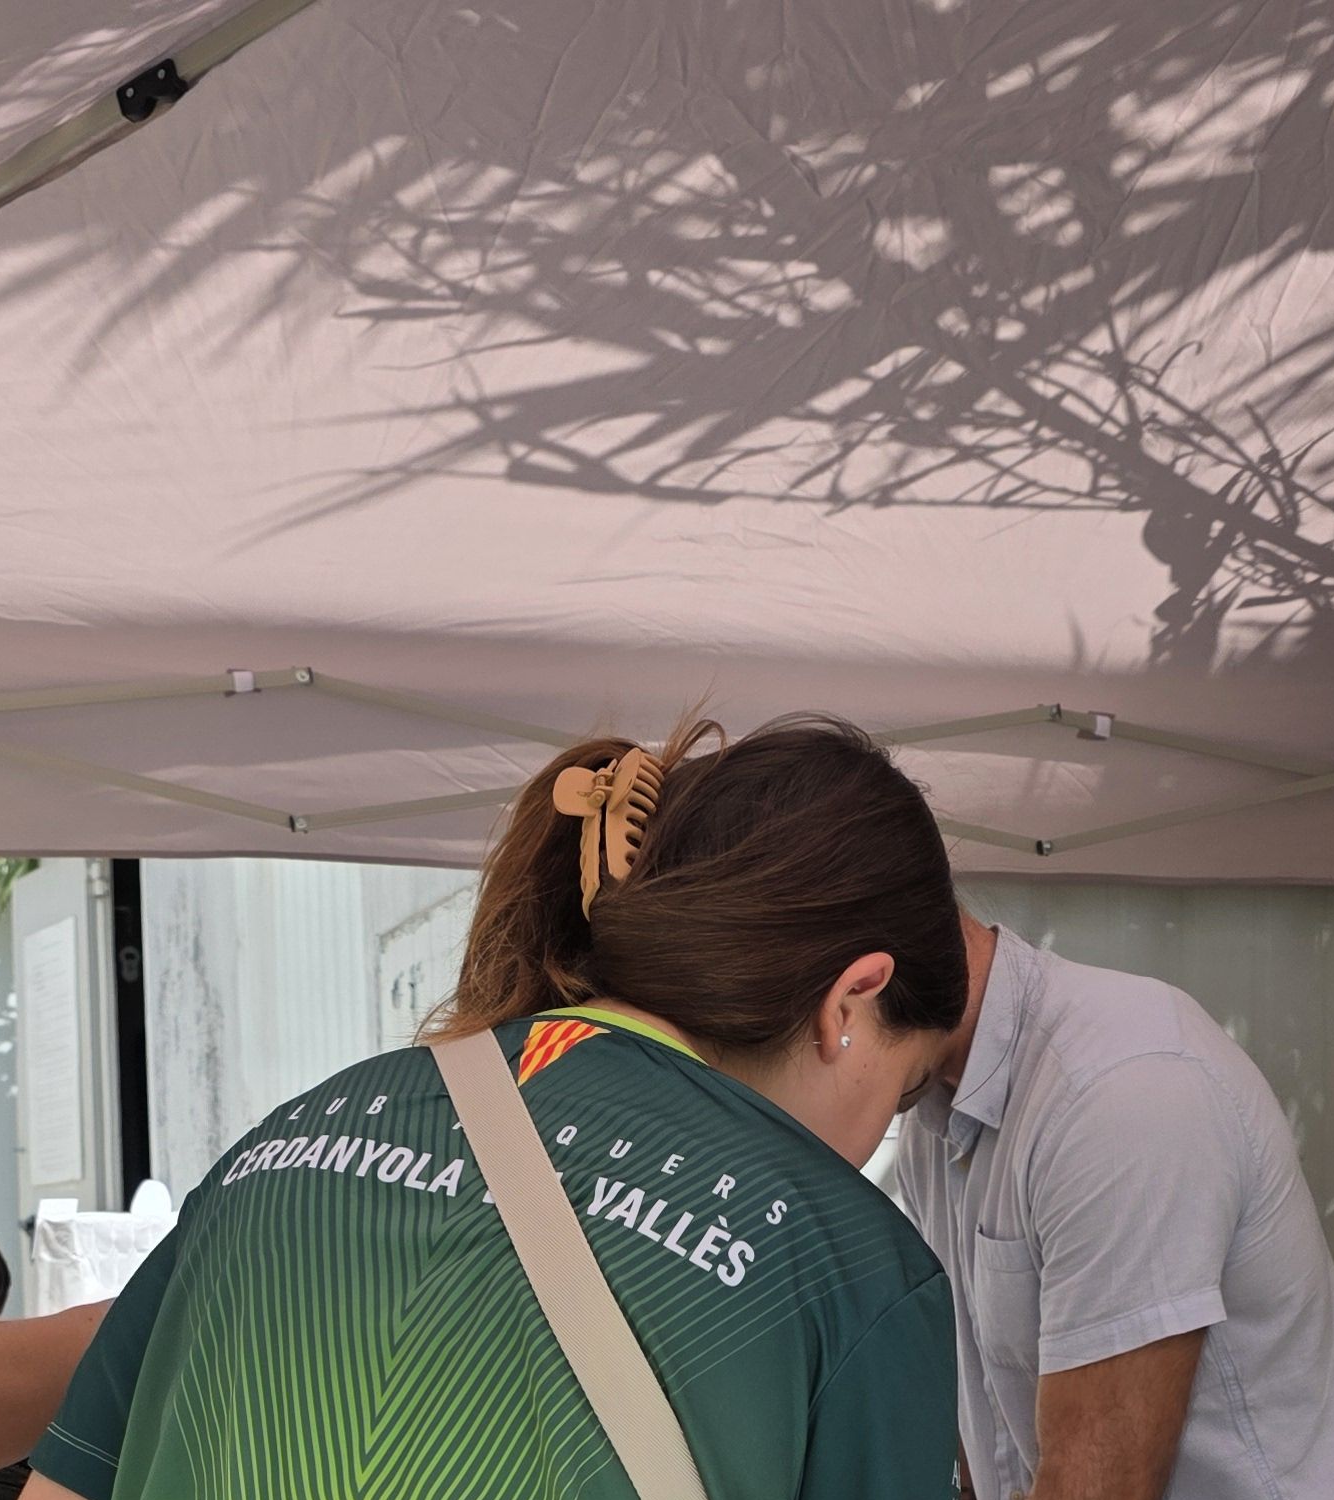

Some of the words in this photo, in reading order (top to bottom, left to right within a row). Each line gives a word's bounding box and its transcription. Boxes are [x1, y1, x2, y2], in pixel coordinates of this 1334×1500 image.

[221, 1134, 465, 1198] CERDANYOLA
[586, 1176, 755, 1287] VALLÈS
[257, 1095, 387, 1128] LUB
[452, 1121, 788, 1225] QUERS
